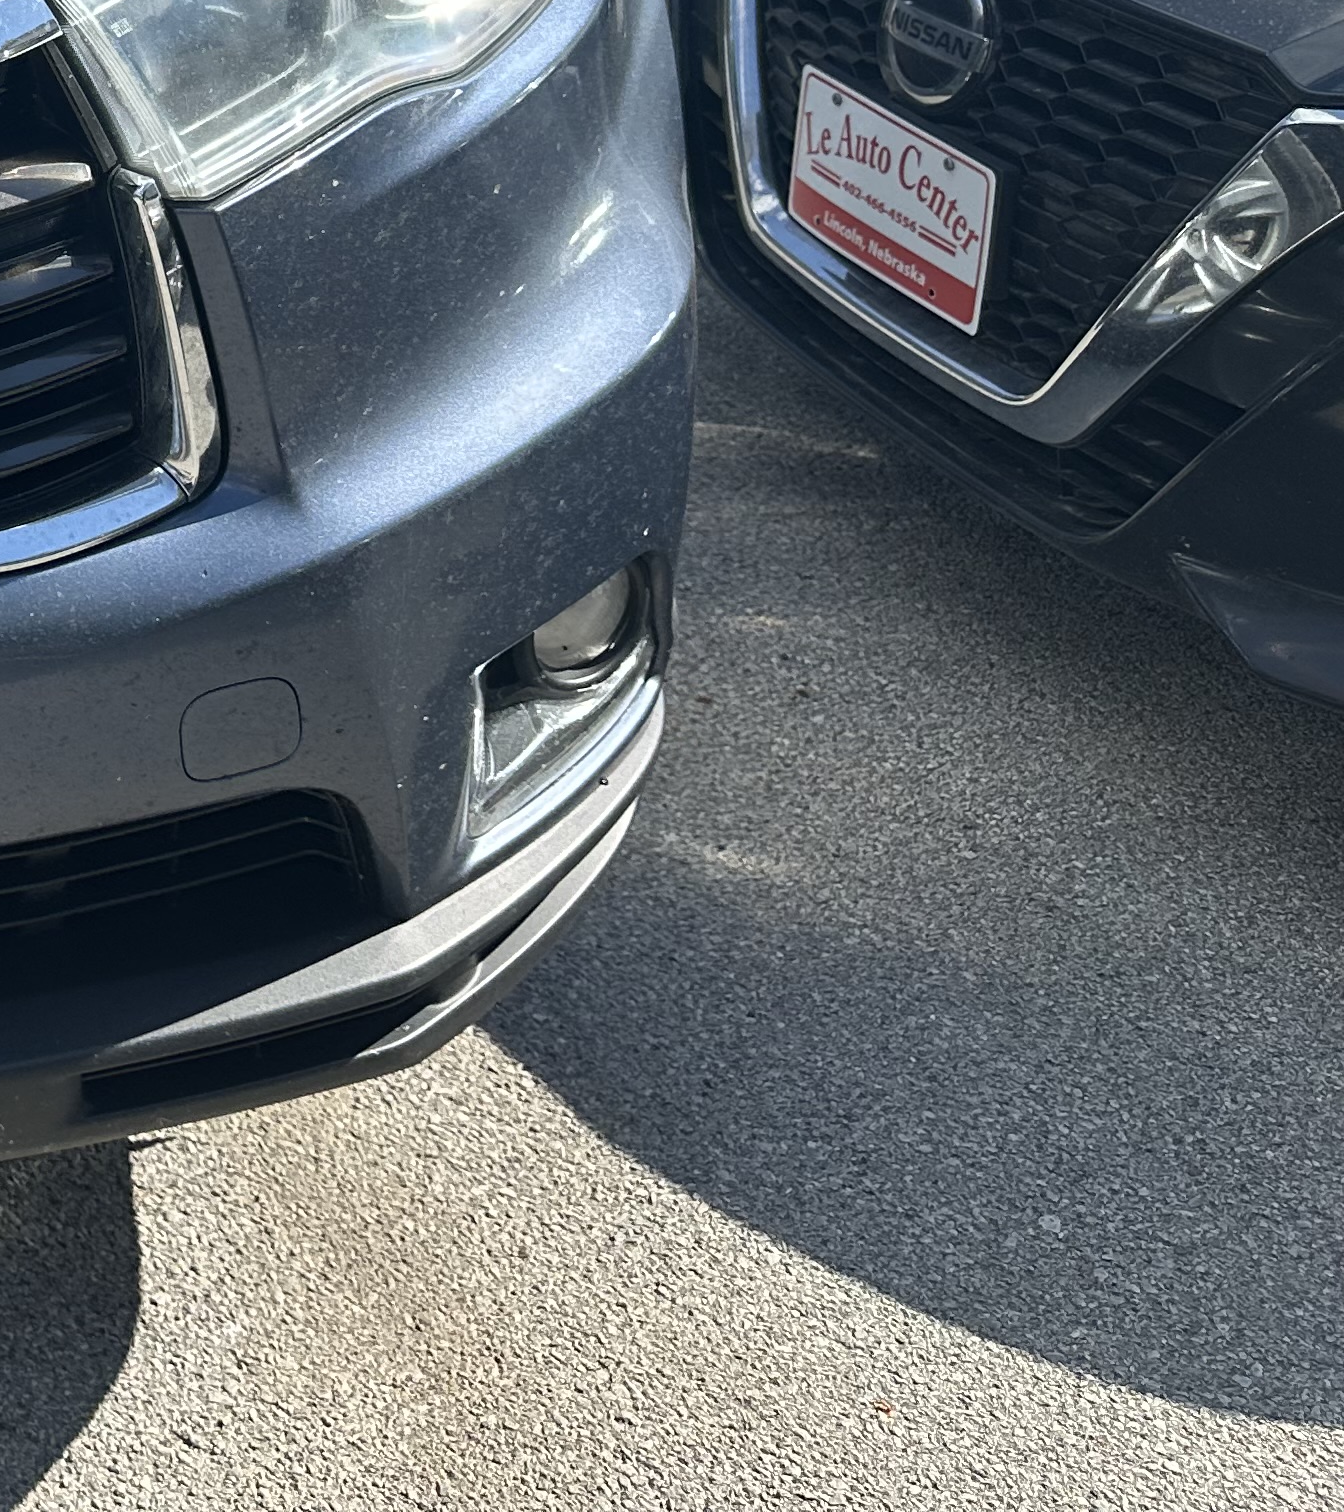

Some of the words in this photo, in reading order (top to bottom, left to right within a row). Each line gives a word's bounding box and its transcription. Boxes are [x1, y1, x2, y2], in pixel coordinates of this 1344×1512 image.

[891, 7, 973, 61] NISSAN
[805, 111, 833, 156] Le
[835, 114, 891, 175] Auto
[898, 144, 980, 255] Center
[841, 179, 918, 233] 402-466-4556
[823, 210, 867, 253] Lincoln,
[867, 239, 926, 287] Nebraska
